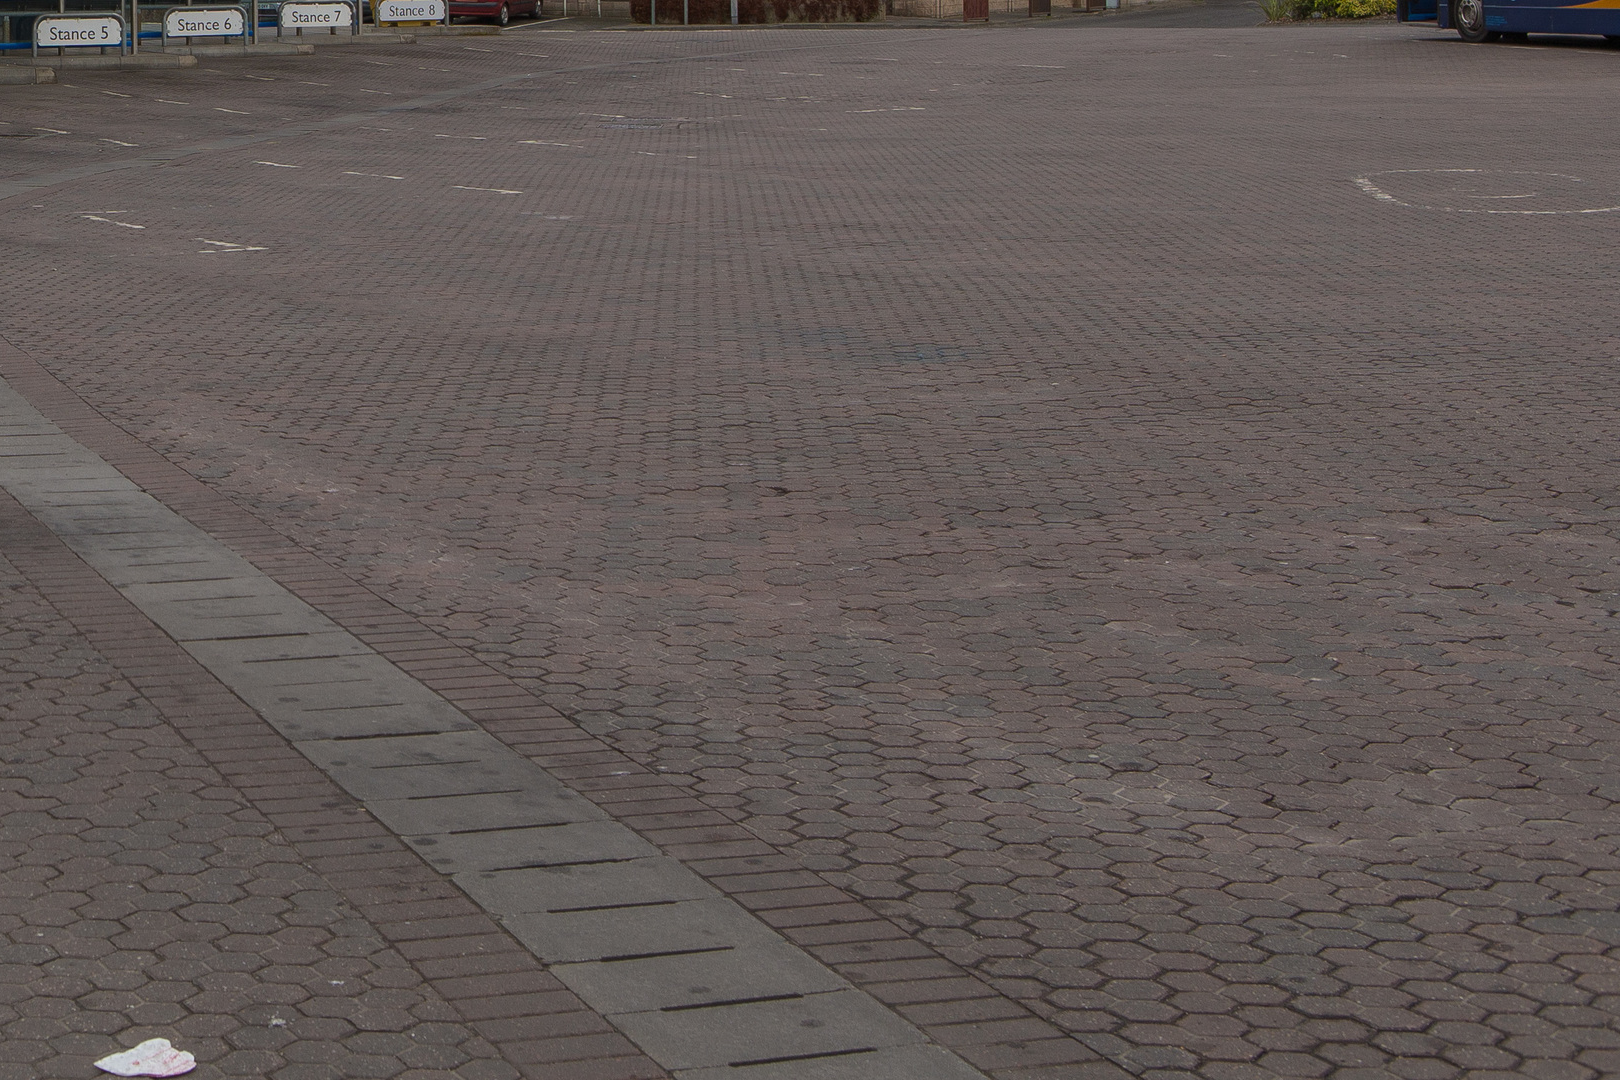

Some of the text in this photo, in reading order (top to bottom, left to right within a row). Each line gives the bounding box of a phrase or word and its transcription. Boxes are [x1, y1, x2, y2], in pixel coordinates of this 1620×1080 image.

[291, 10, 342, 23] Stance 7
[389, 4, 436, 17] Stance 8
[177, 18, 232, 32] Stance 6
[49, 26, 109, 41] Stance 5
